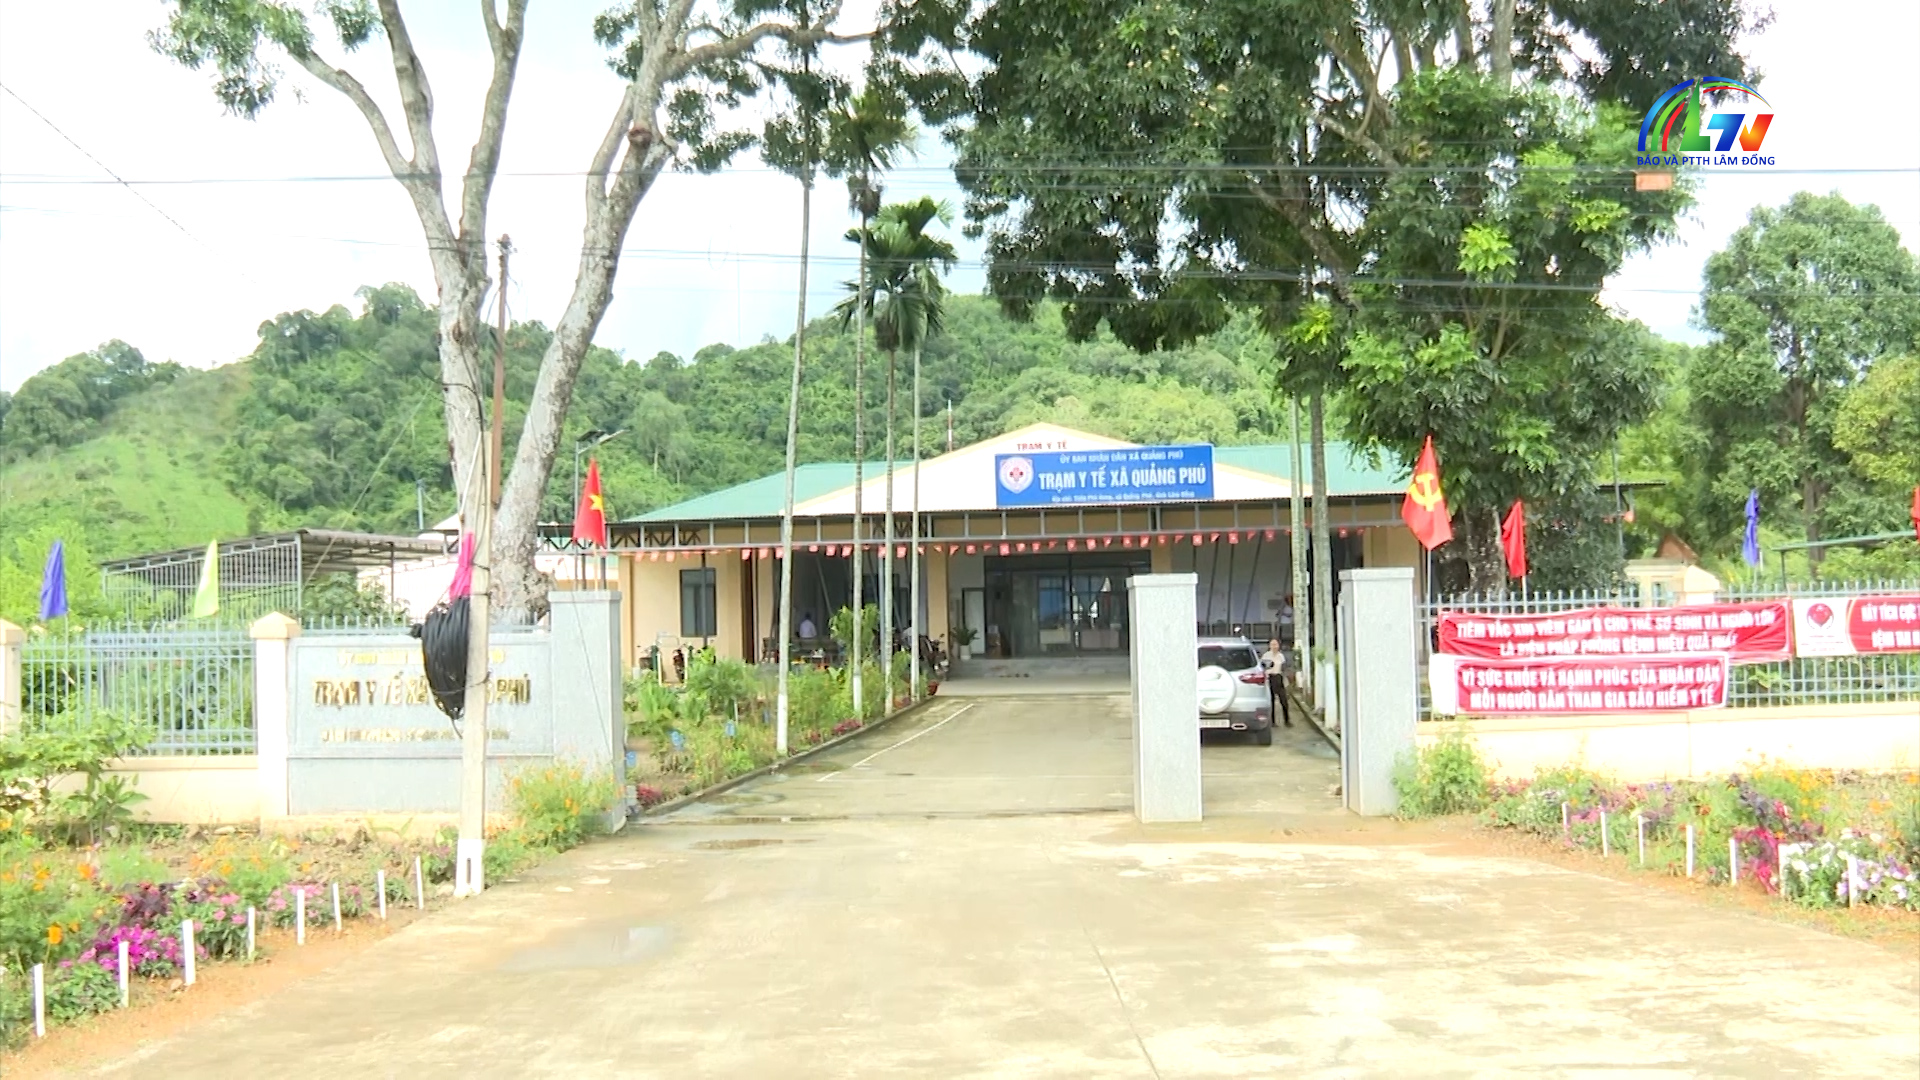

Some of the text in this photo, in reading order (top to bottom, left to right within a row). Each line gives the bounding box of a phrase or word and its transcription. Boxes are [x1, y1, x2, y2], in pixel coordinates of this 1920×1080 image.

[1038, 461, 1207, 493] TRẠM Y TẾ XÃ QUẢNG PHÚ
[1604, 616, 1629, 632] CHO
[1704, 611, 1720, 629] VÀ
[1500, 639, 1515, 656] LÀ
[1687, 631, 1710, 651] QUẢ
[1462, 667, 1475, 686] VÌ
[1477, 668, 1503, 686] SỨC
[1505, 667, 1537, 686] KHỎE
[1539, 667, 1555, 686] VÀ
[1558, 668, 1592, 690] HẠNH
[1594, 666, 1629, 686] PHÚC
[1631, 664, 1656, 685] CỦA
[1659, 664, 1695, 684] NHÂN
[312, 678, 361, 710] TRẠM
[365, 680, 378, 706] Y
[380, 671, 404, 706] TẾ
[494, 672, 532, 706] PHÚ
[1497, 689, 1536, 708] NGƯỜI
[1538, 689, 1565, 708] DÂN
[1567, 691, 1602, 708] THAM
[1604, 690, 1626, 708] GIA
[1628, 685, 1654, 707] BẢO
[1656, 684, 1688, 706] HIỂM
[1690, 688, 1698, 705] Y
[1700, 684, 1715, 704] TẾ
